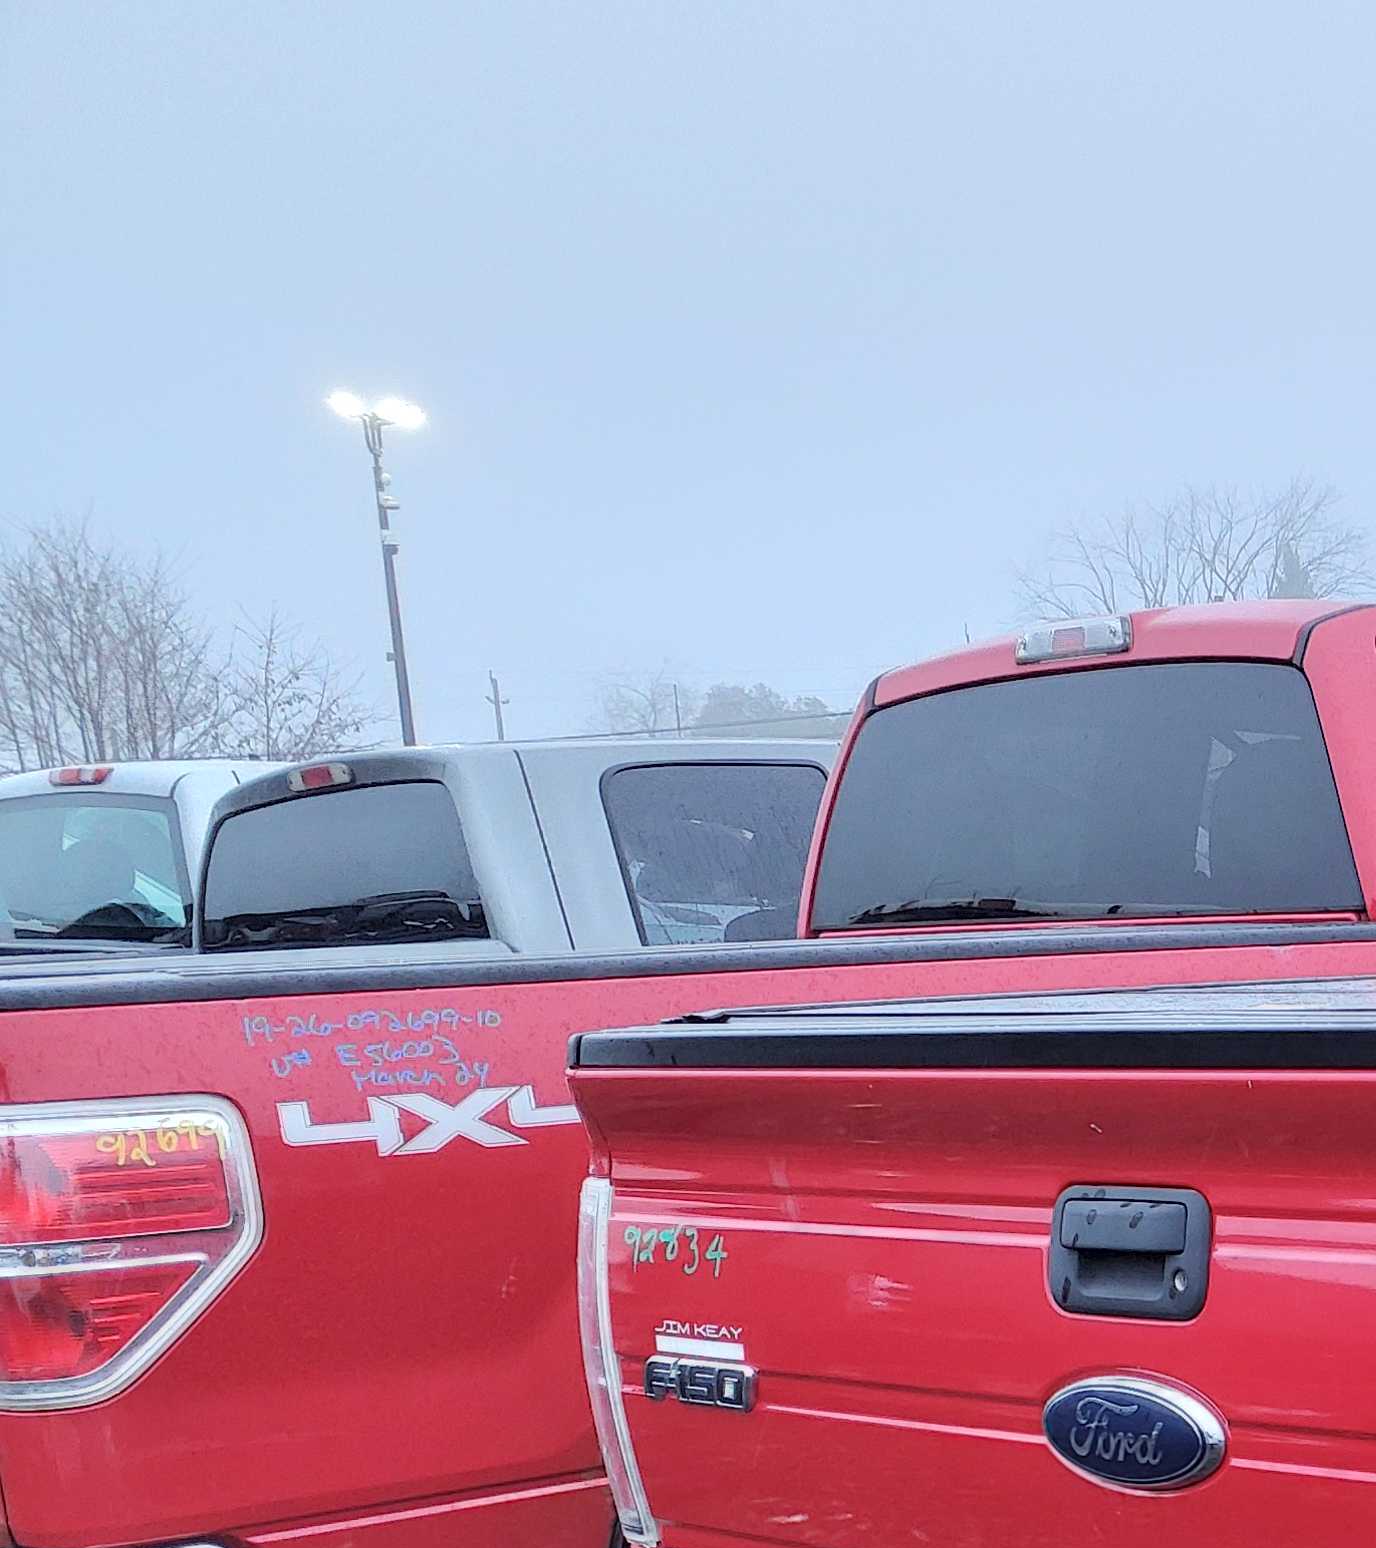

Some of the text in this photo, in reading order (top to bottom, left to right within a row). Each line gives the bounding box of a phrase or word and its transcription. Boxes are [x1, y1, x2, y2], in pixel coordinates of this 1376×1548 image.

[623, 1224, 729, 1280] 92834
[654, 1319, 744, 1341] JIM KEAY
[1067, 1395, 1166, 1468] Ford
